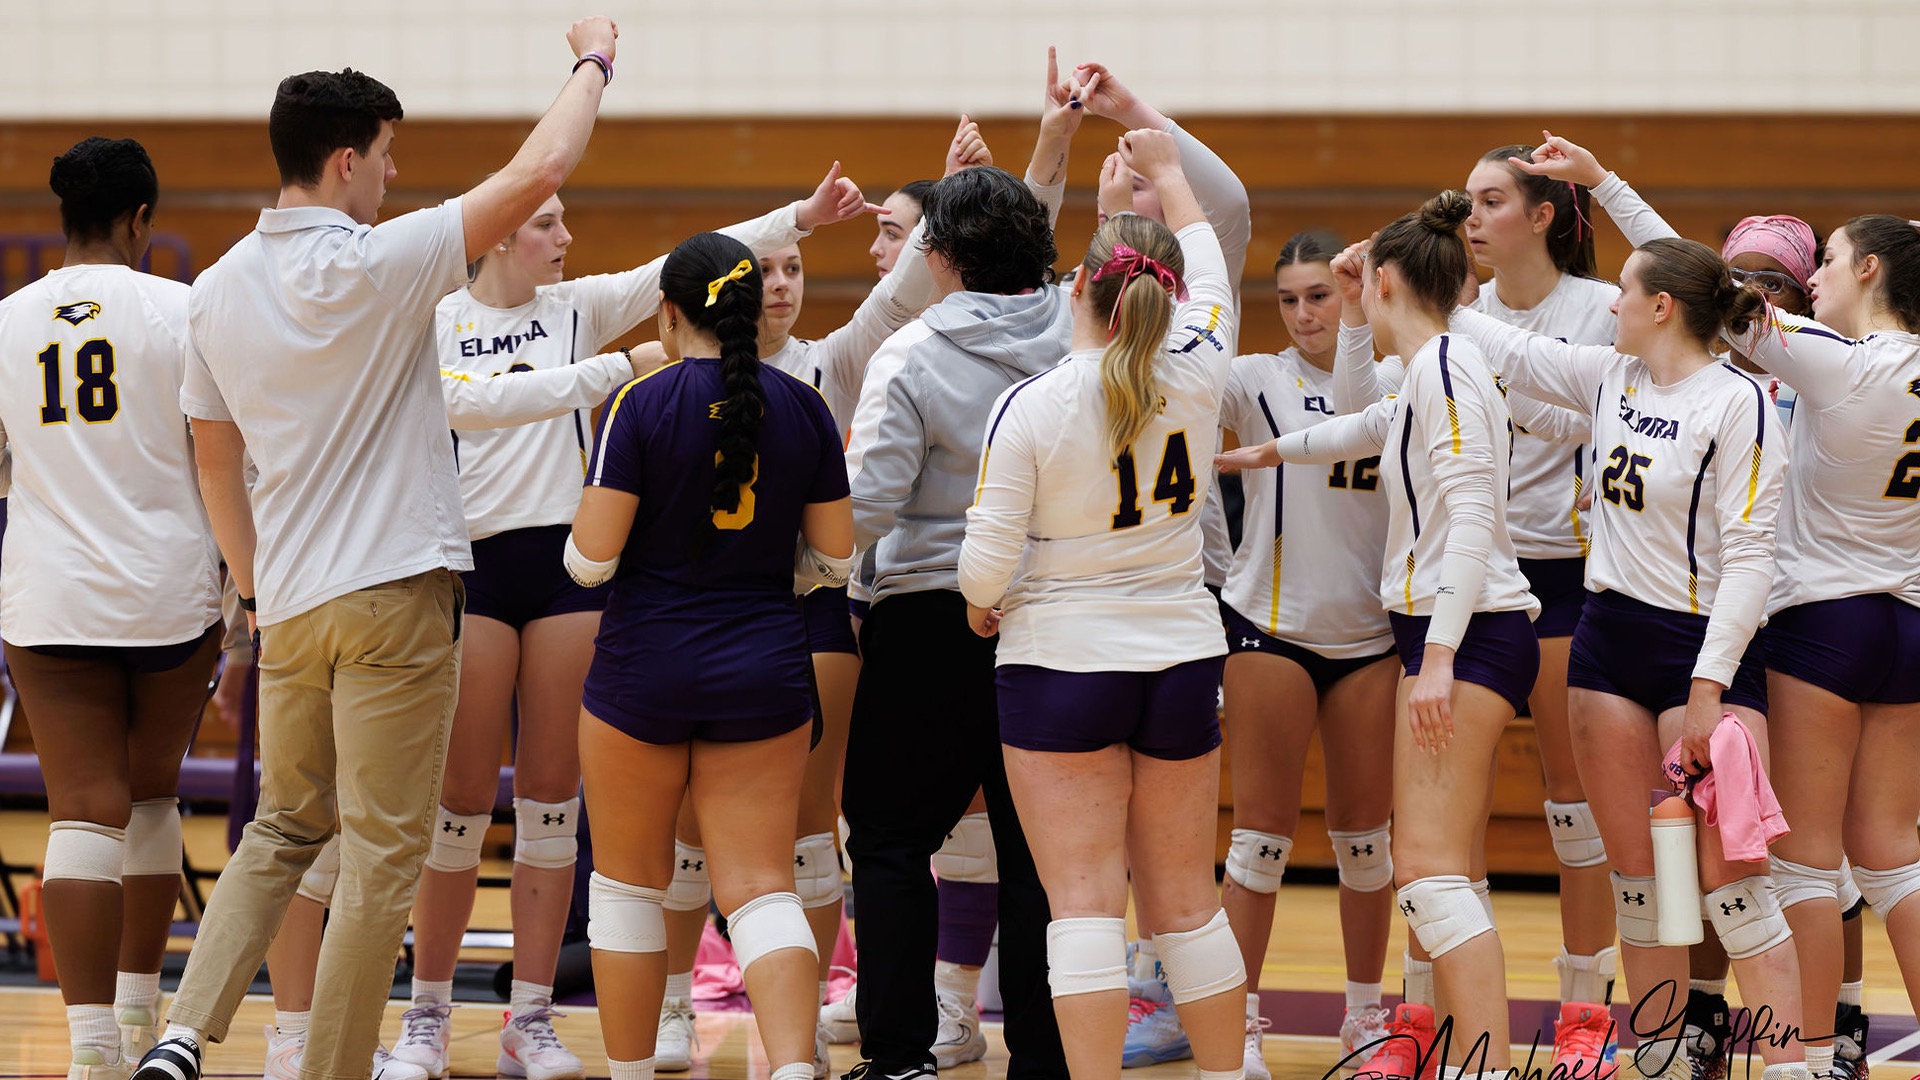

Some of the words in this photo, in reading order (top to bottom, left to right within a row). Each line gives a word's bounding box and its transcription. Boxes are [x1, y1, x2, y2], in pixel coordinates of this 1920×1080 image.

[36, 336, 121, 427] 18
[1109, 427, 1196, 532] 14
[1327, 454, 1382, 493] 12
[1600, 443, 1653, 515] 25
